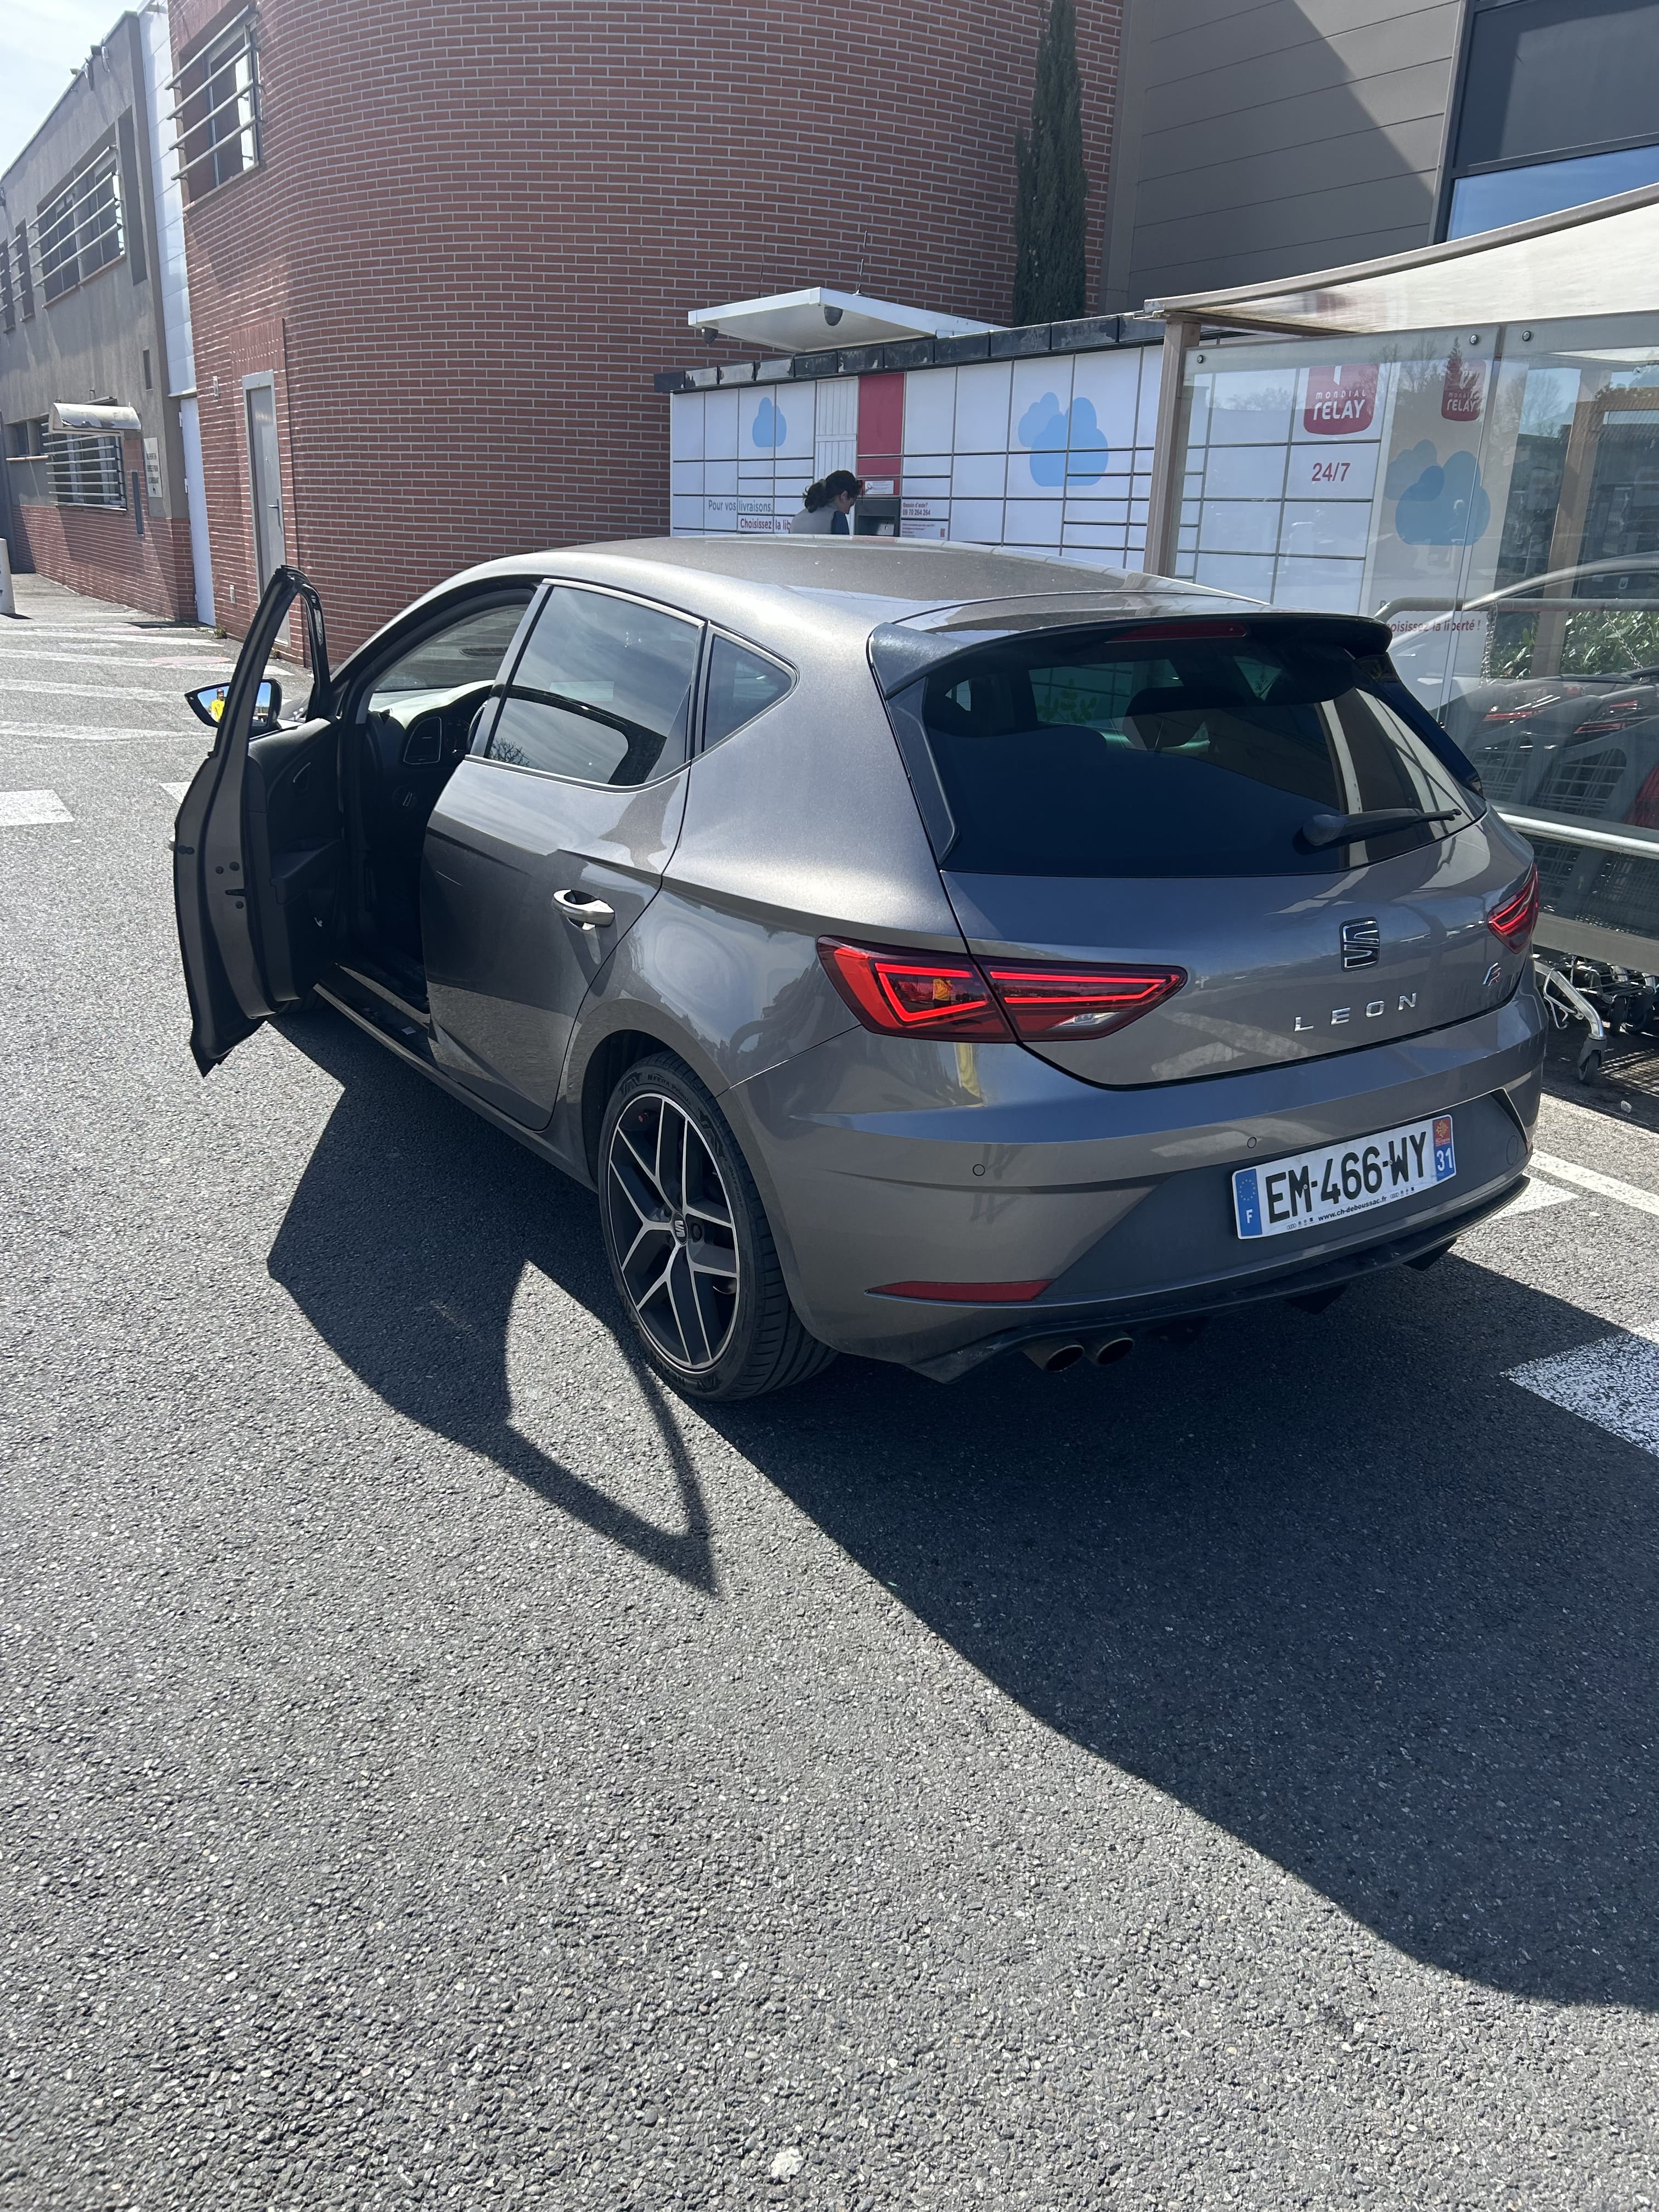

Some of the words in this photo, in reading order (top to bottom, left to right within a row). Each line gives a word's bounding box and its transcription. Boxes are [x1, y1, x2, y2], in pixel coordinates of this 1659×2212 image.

[1312, 462, 1351, 482] 24/7
[708, 499, 723, 511] Pour
[725, 501, 736, 511] vos
[738, 500, 773, 513] livraisons,
[740, 518, 772, 529] Choisissez
[775, 519, 781, 530] la
[1294, 992, 1417, 1032] LEON
[1436, 1147, 1453, 1172] 31
[1265, 1131, 1426, 1224] EM-466-WY
[1246, 1209, 1254, 1224] F
[1318, 1195, 1387, 1222] www.ch-deboussac.fr
